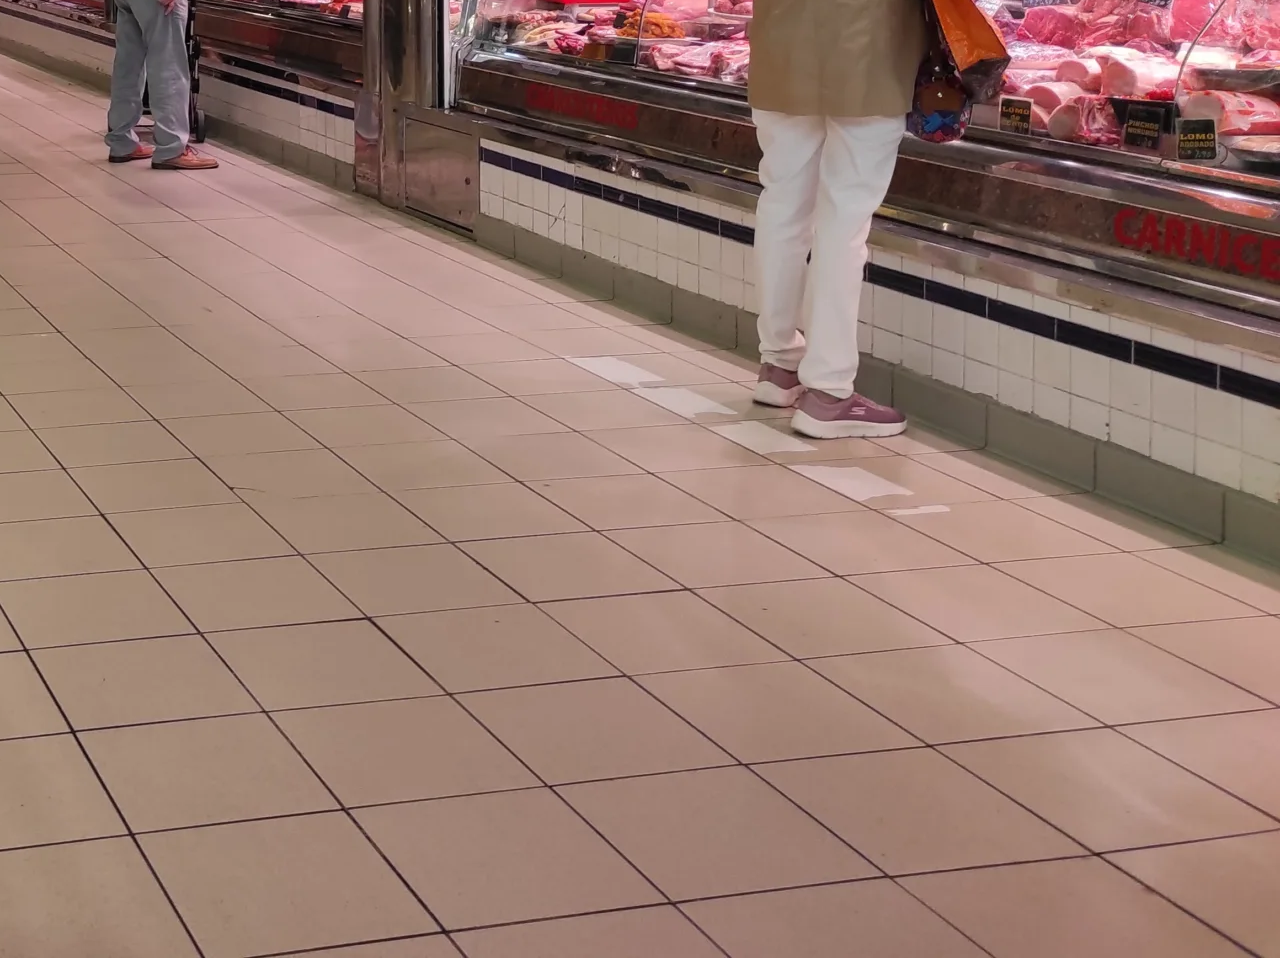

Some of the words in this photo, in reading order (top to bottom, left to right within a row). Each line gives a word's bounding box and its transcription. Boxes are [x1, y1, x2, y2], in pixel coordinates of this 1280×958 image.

[1002, 105, 1030, 115] LOMO
[1128, 119, 1160, 130] PINCHOS
[1180, 133, 1214, 141] LOMO
